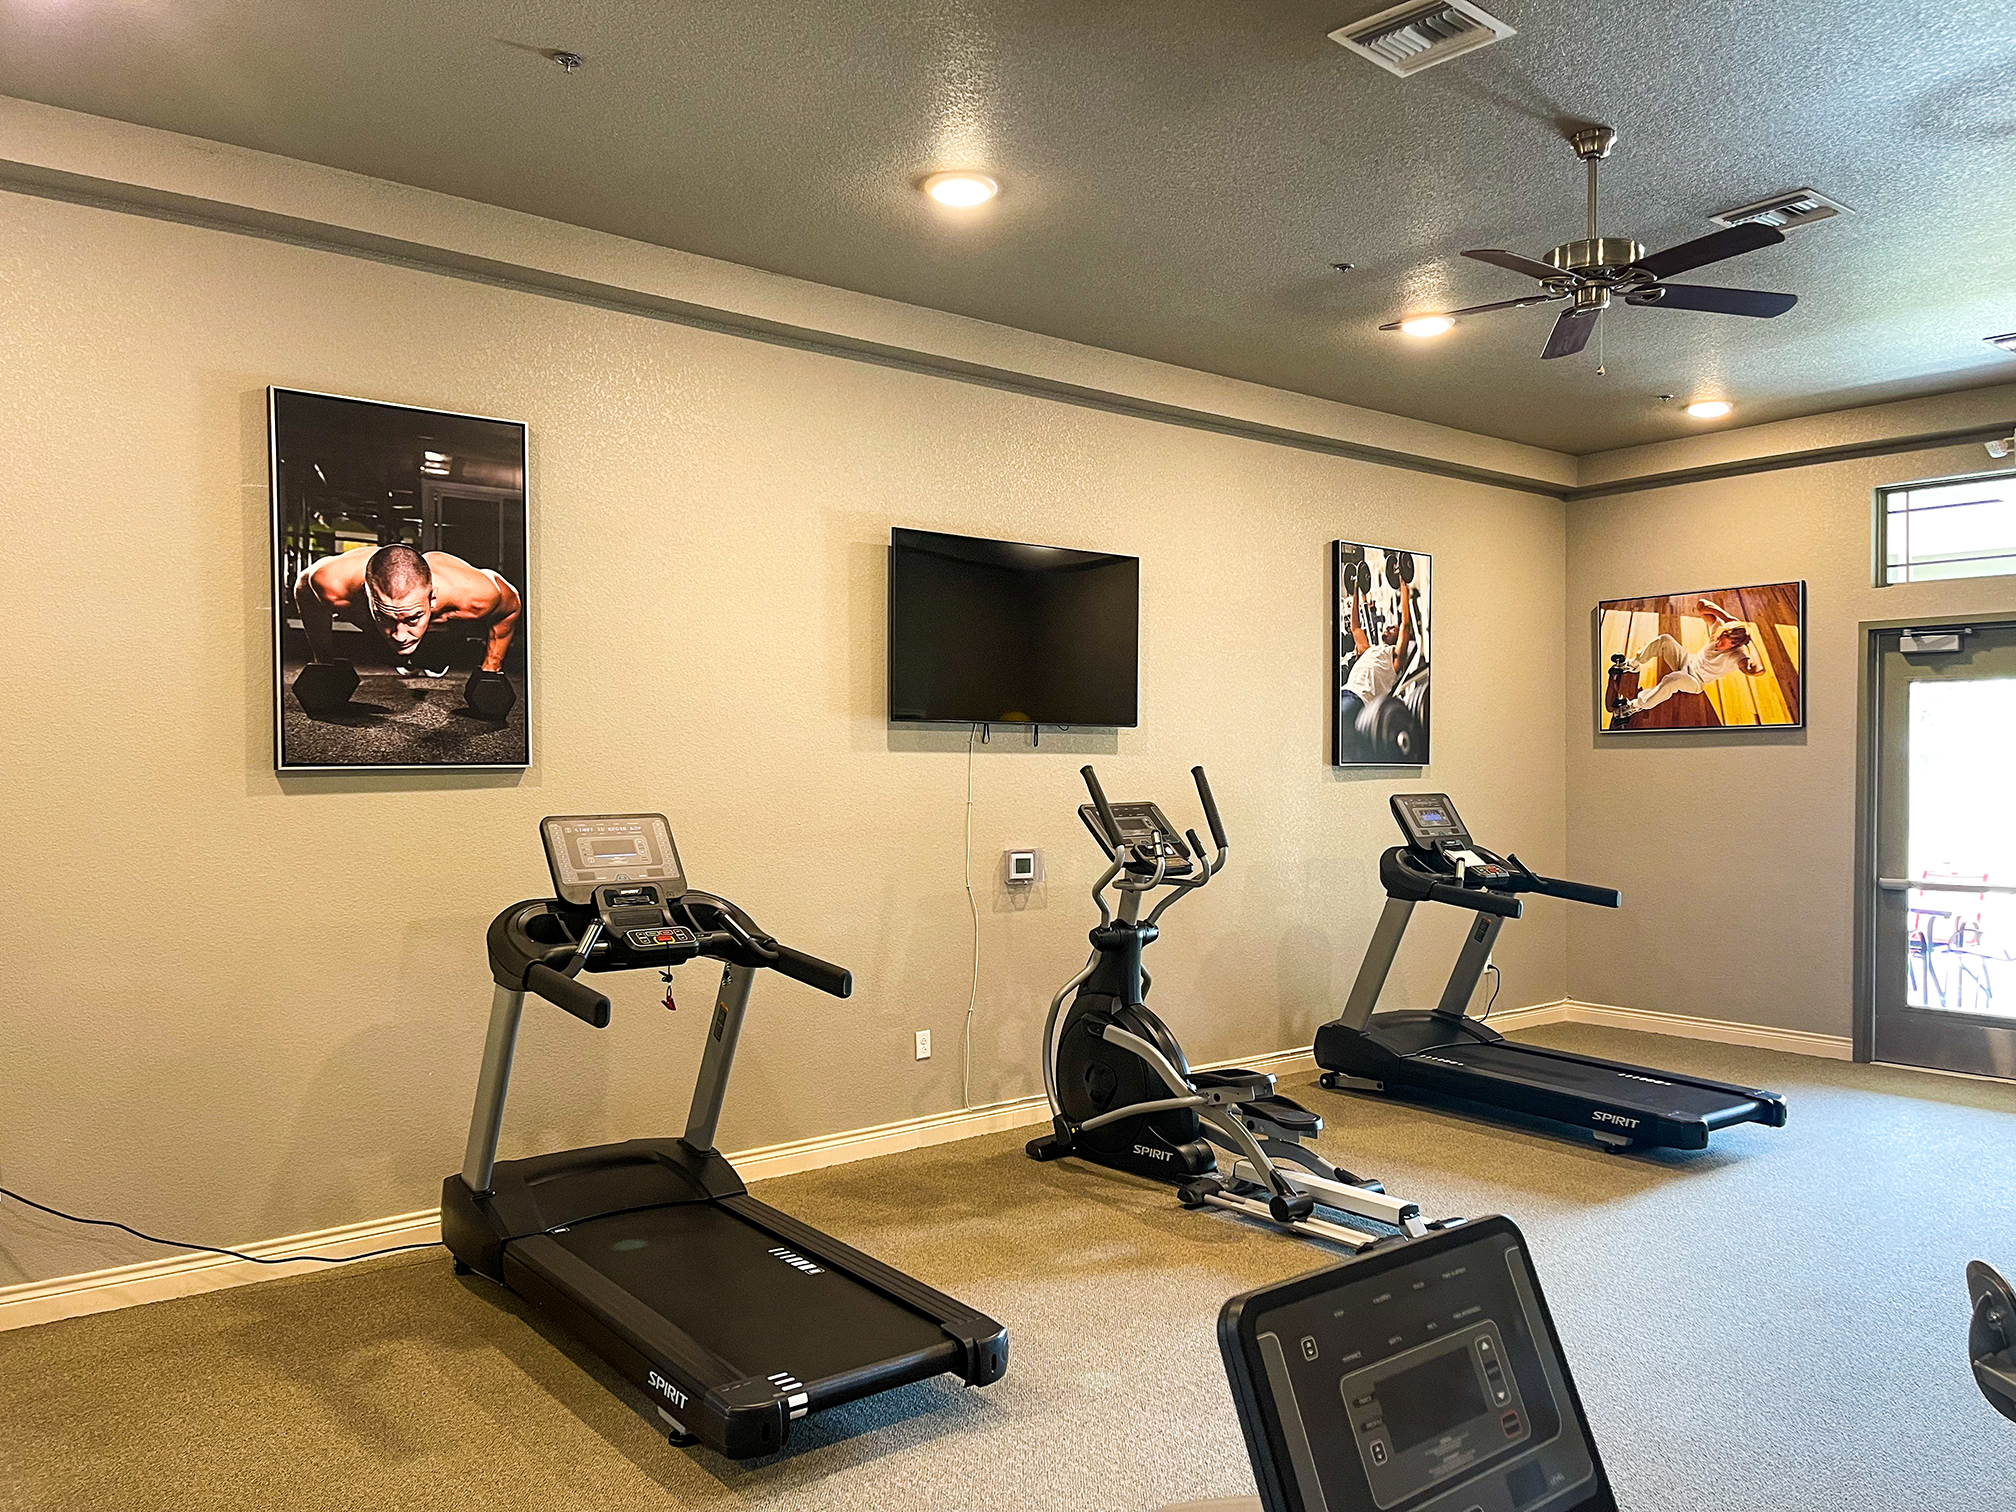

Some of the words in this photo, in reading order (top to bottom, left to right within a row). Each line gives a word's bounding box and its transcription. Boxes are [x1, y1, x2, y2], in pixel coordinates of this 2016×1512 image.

[1591, 1110, 1640, 1129] SPIRIT
[1132, 1144, 1174, 1162] SPIRIT
[647, 1370, 689, 1410] SPIRIT
